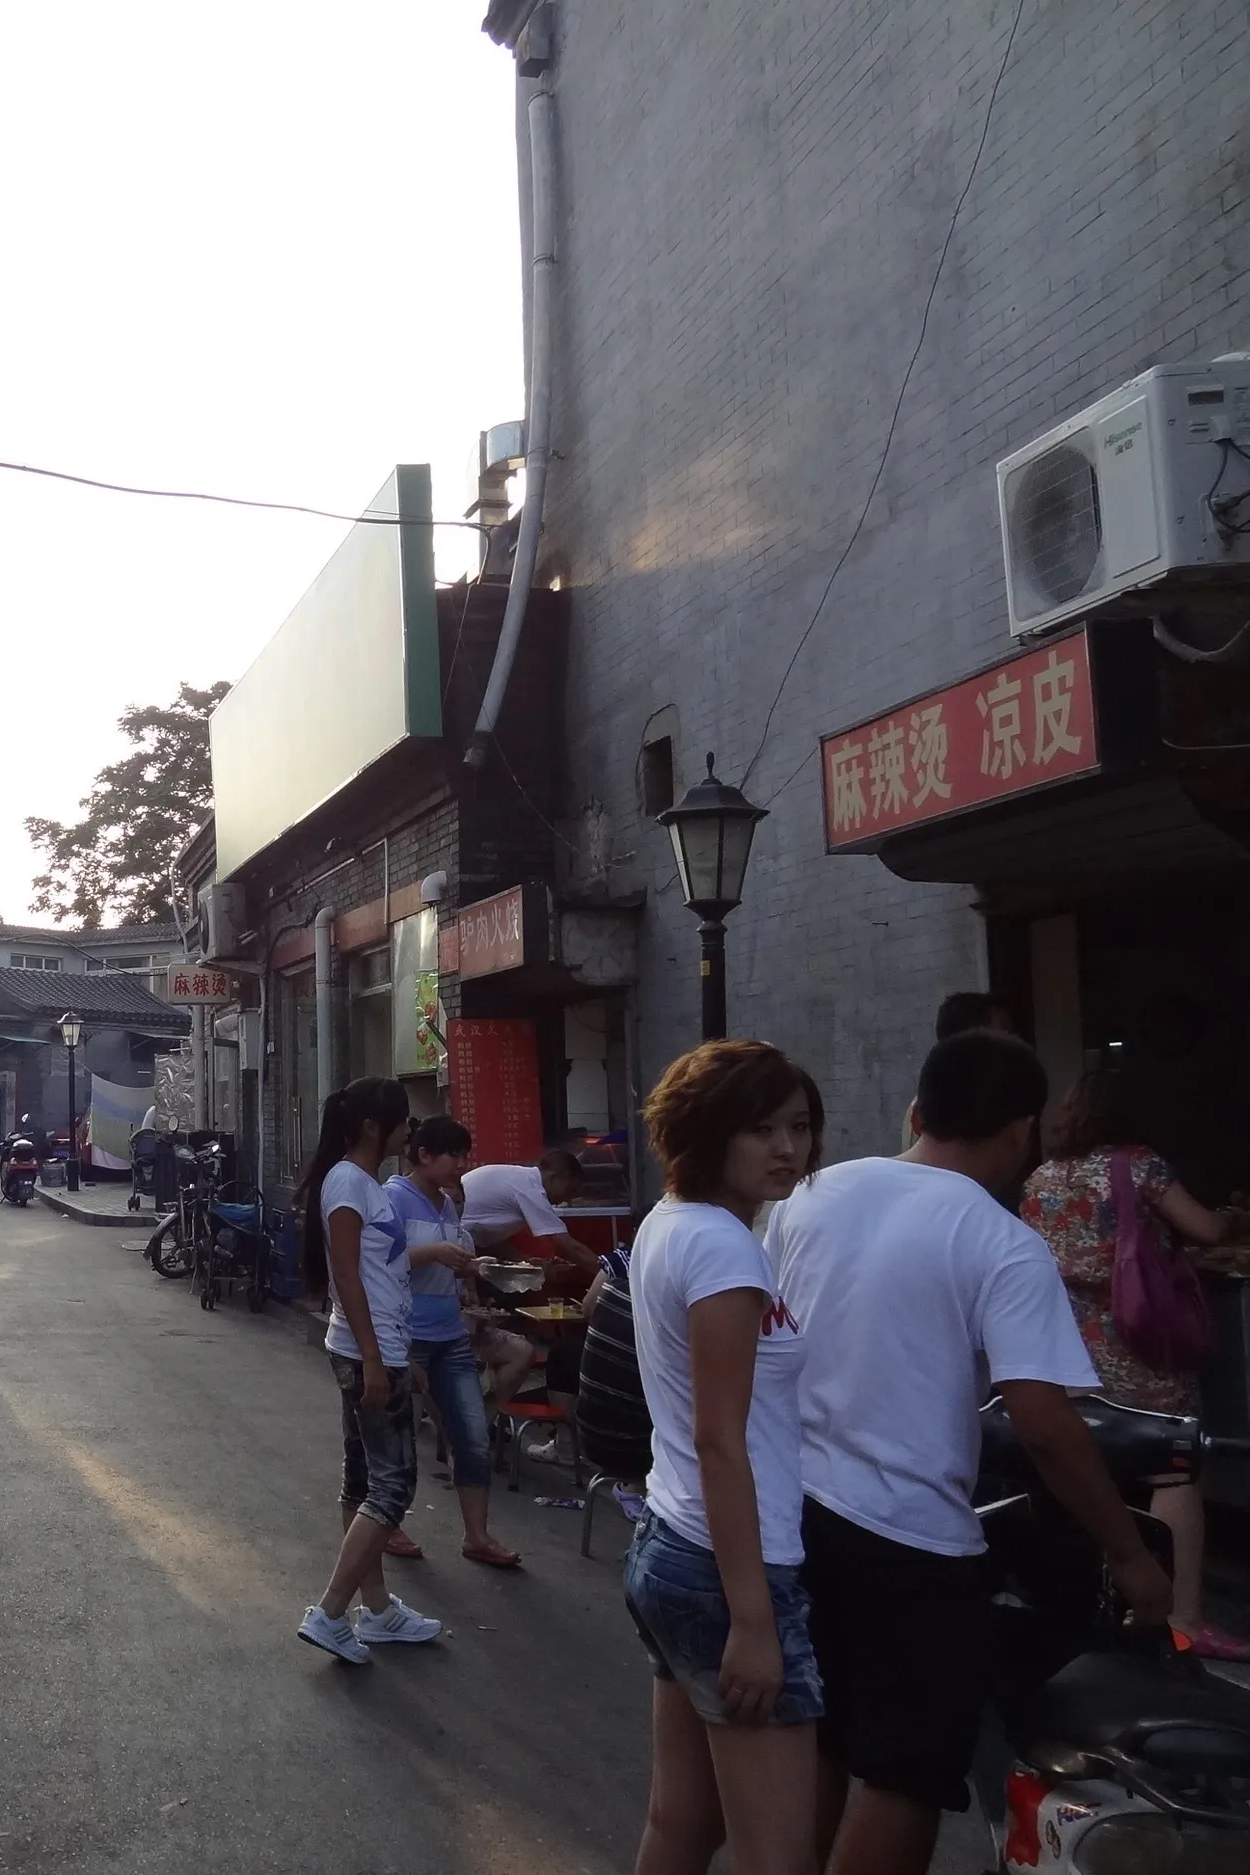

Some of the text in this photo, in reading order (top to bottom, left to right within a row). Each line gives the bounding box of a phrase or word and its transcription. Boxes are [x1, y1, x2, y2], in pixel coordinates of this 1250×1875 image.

[830, 650, 1082, 832] 麻辣烫 凉皮
[173, 972, 227, 997] 麻辣烫
